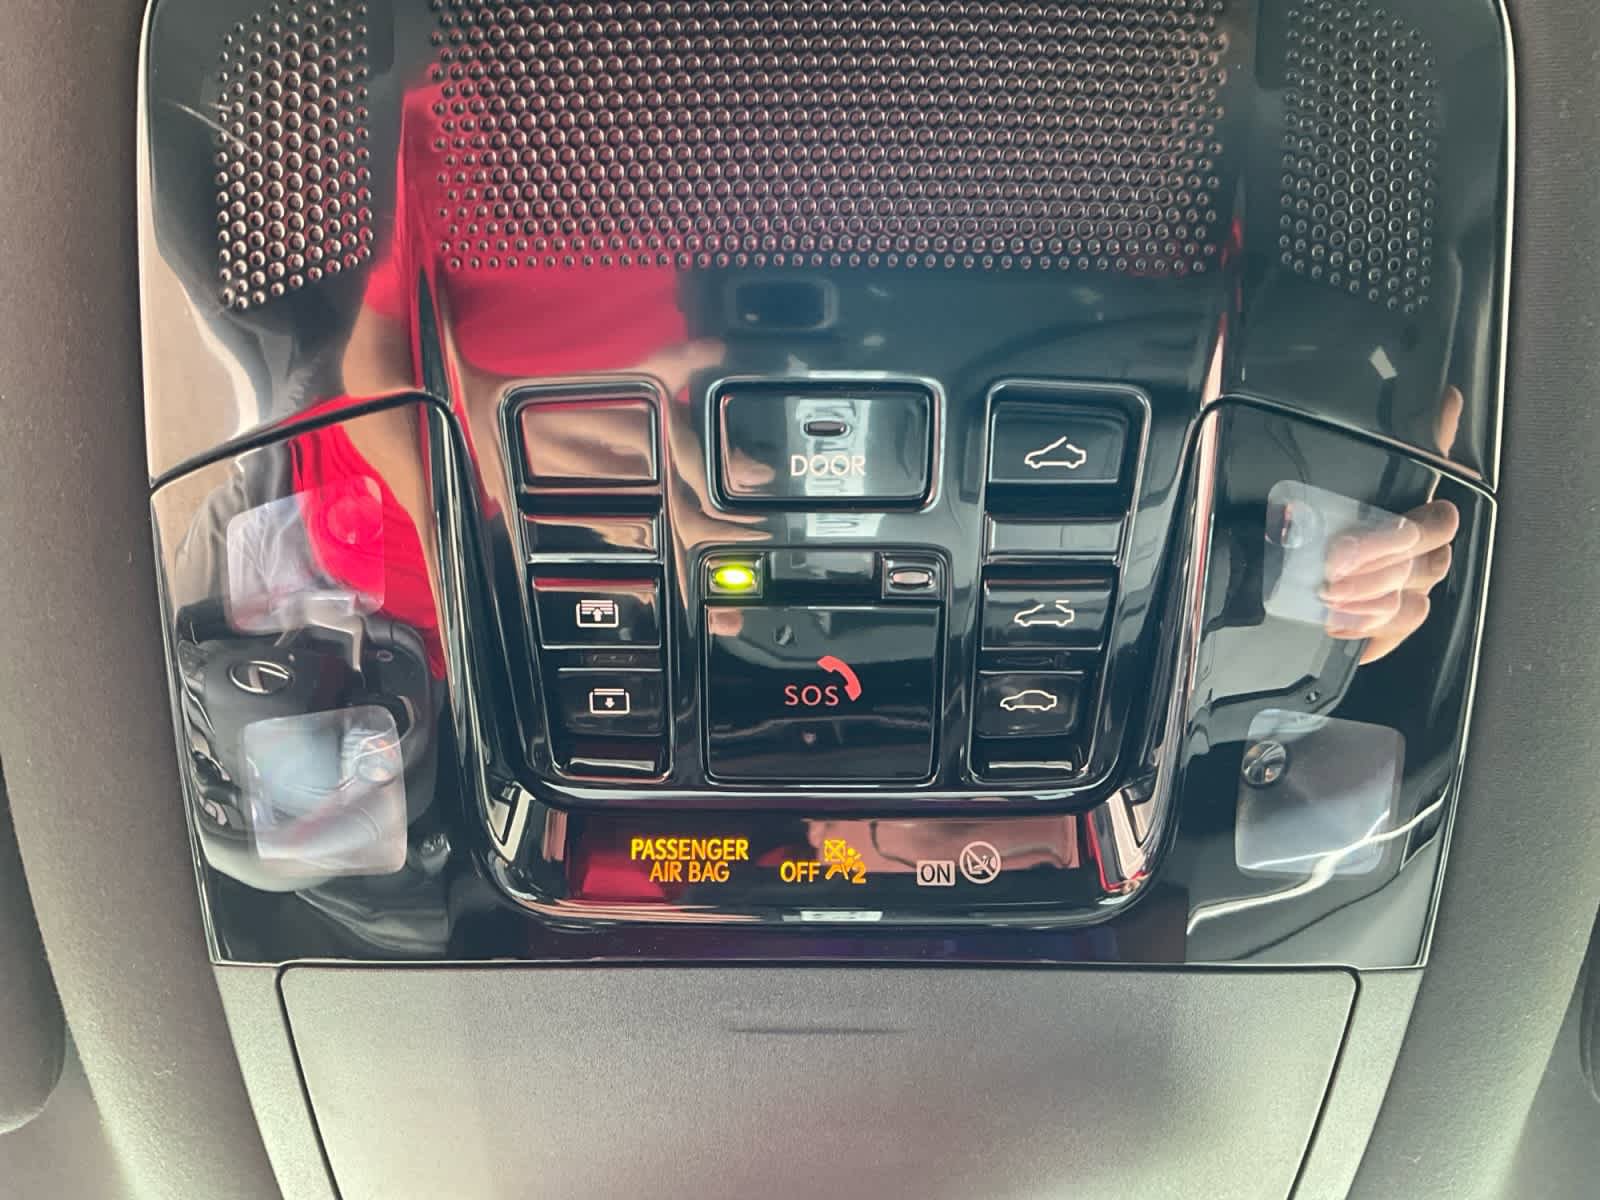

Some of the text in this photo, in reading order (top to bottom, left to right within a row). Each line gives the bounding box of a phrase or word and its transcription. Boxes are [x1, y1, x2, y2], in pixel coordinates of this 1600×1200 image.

[791, 455, 866, 476] DOOR
[784, 685, 839, 706] SOS
[631, 838, 749, 861] PASSENGER
[649, 861, 730, 883] AIR BAG
[780, 861, 820, 883] OFF
[919, 862, 952, 884] ON
